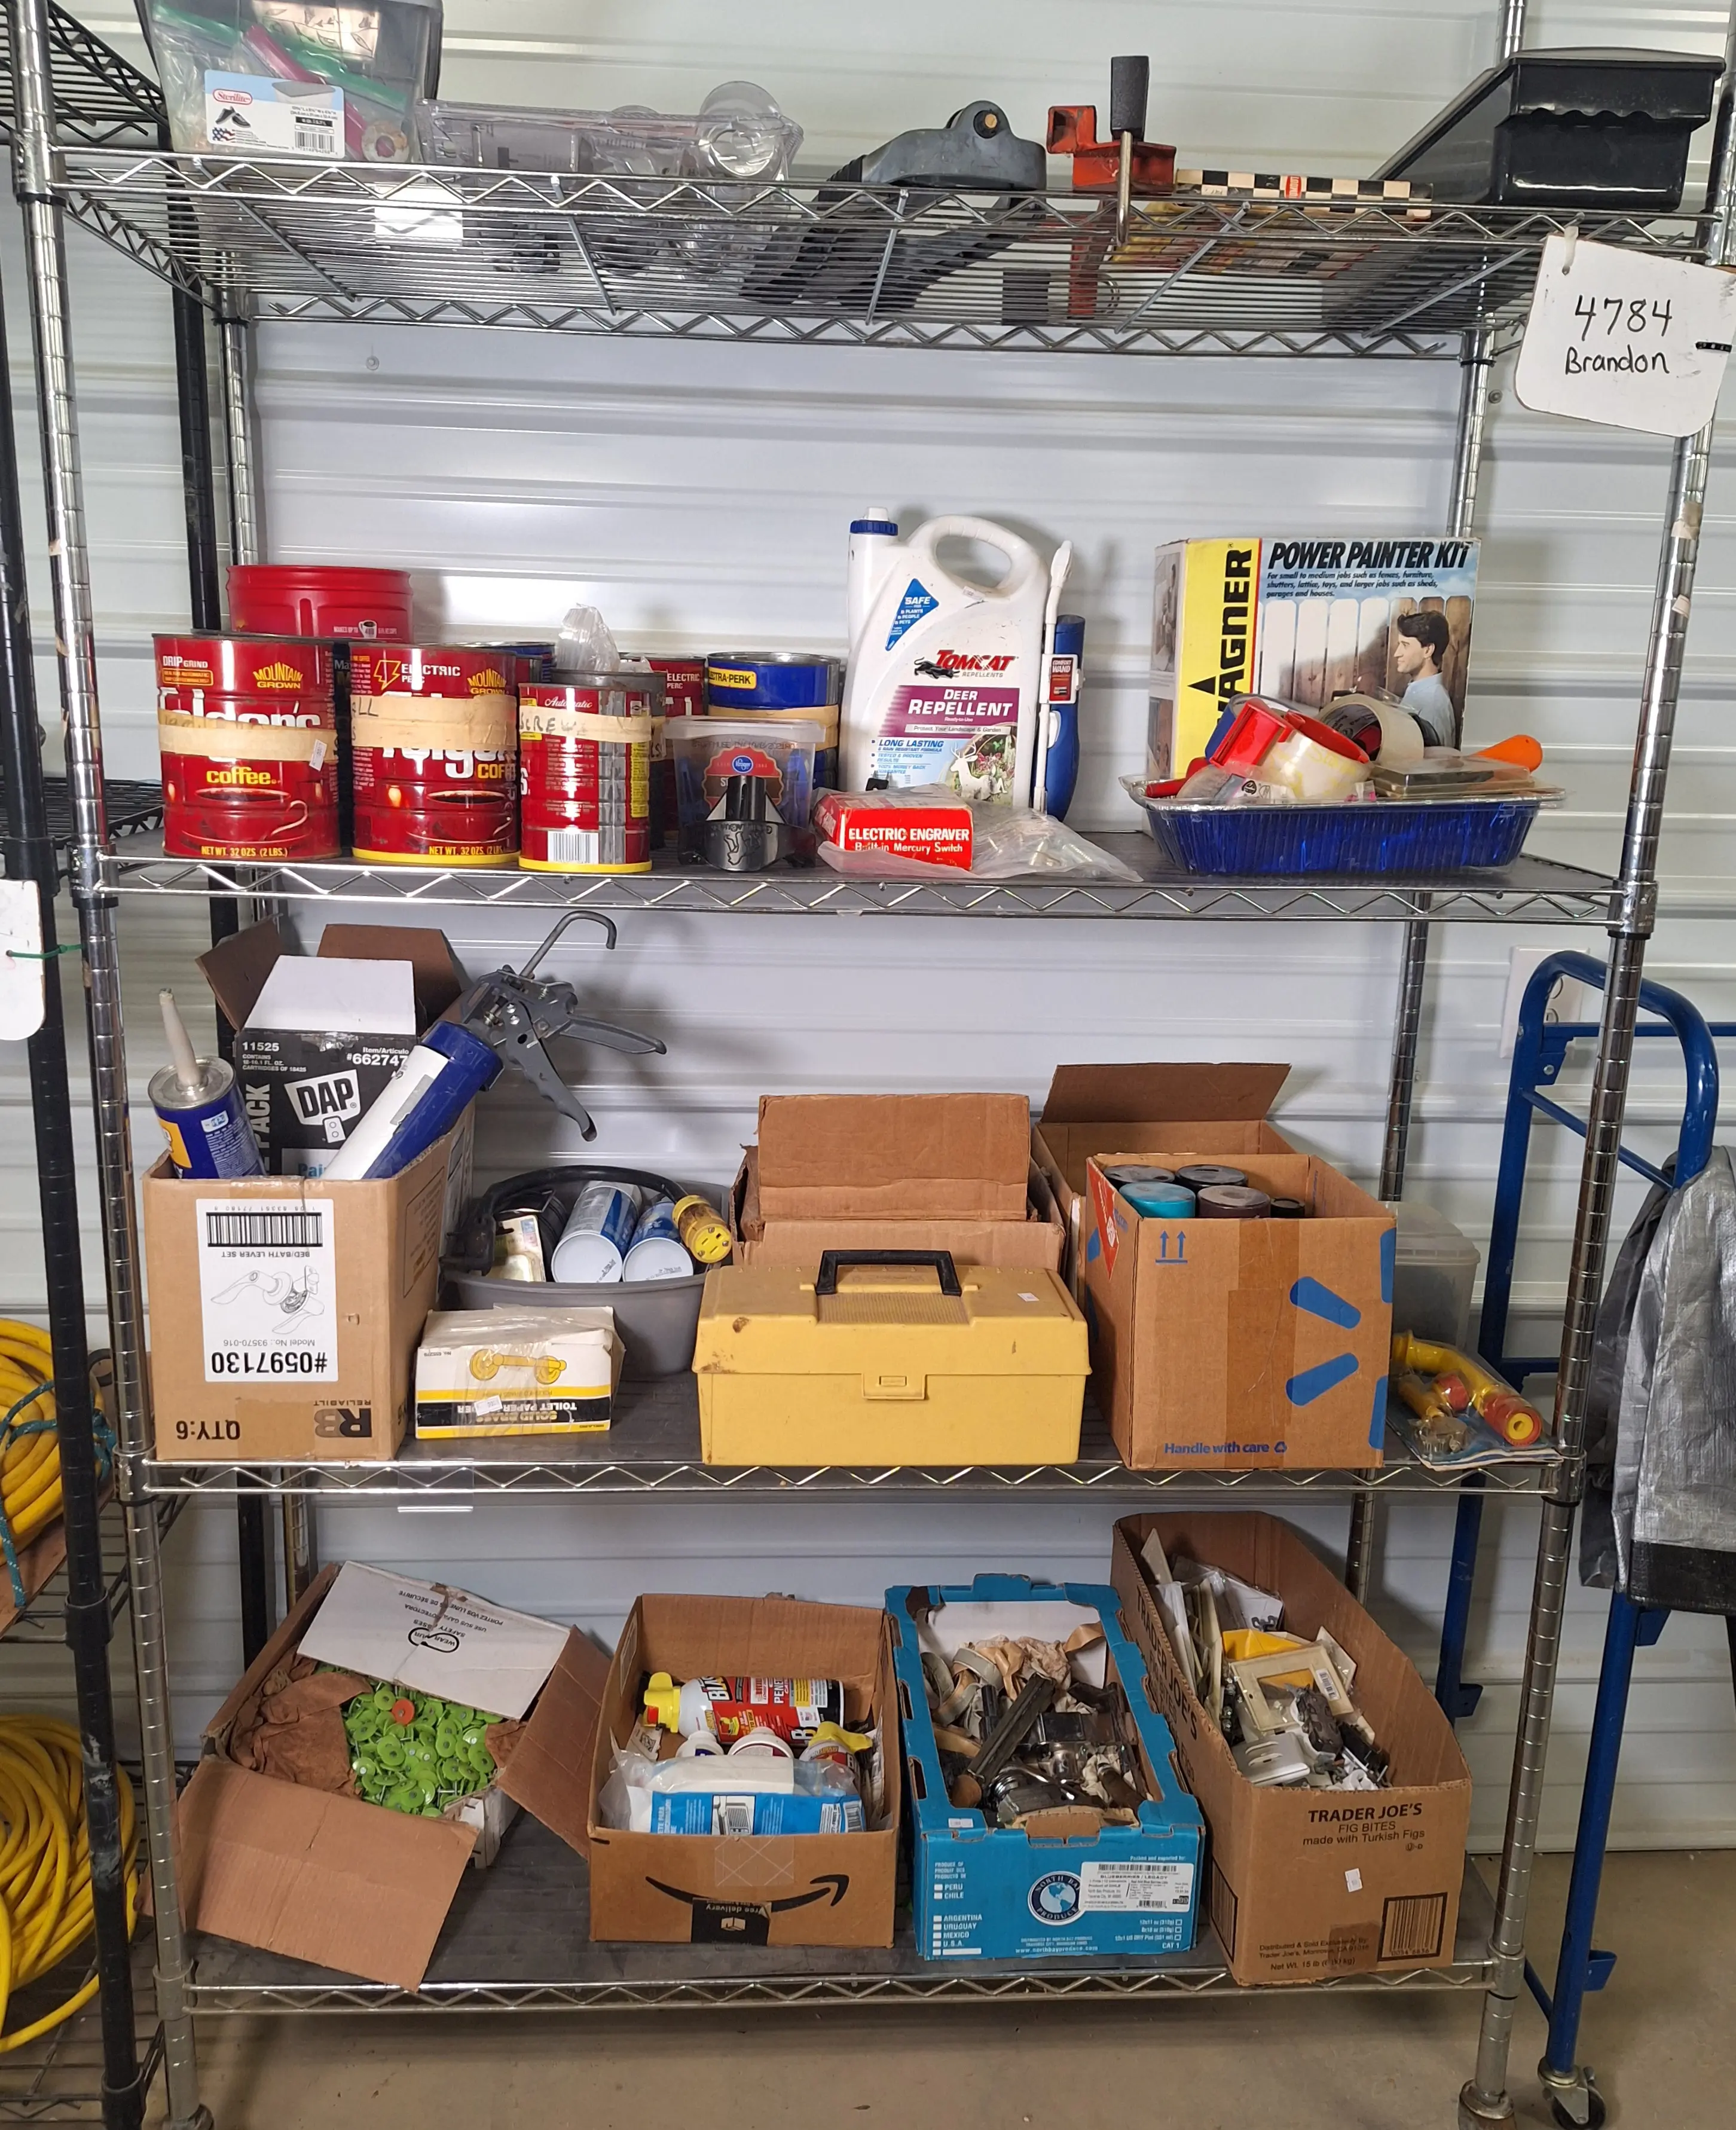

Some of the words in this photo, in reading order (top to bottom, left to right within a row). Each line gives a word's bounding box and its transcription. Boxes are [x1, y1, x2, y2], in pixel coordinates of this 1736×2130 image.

[218, 91, 248, 103] Sterilite
[1575, 295, 1673, 341] 4784
[1565, 344, 1670, 375] Brandon
[1268, 542, 1346, 569] POWER
[1346, 542, 1434, 569] PAINTER
[1434, 542, 1474, 569] KIT
[1337, 572, 1350, 580] jobs
[1298, 580, 1320, 589] lattice,
[1355, 580, 1374, 589] larger
[1266, 590, 1293, 598] garages
[1217, 549, 1252, 725] AGNER
[163, 656, 183, 667] DRIP
[184, 660, 208, 668] GRIND
[935, 649, 1017, 671] TOMCAT
[253, 662, 303, 682] MOUNTAIN
[402, 664, 461, 676] ELCTRIC
[667, 673, 701, 682] ELECTRIC
[944, 689, 979, 701] DEER
[545, 696, 592, 708] Autoatic
[908, 699, 1013, 716] REPELLENT
[735, 759, 751, 770] Kroger
[206, 766, 271, 784] coffee
[849, 828, 907, 841] ELECTRIC
[910, 828, 969, 841] ENGRAVER
[201, 846, 216, 855] NET
[230, 848, 239, 857] 32
[260, 848, 268, 857] (2
[269, 847, 288, 857] LBS.)
[429, 846, 443, 855] NET
[444, 847, 459, 855] WT.
[461, 847, 470, 855] 32
[470, 847, 485, 855] OZS.
[893, 842, 931, 855] Mercury
[934, 842, 962, 852] Switch
[242, 1042, 280, 1052] 11525
[347, 1053, 408, 1066] #662747
[296, 1078, 354, 1119] DAP
[246, 1083, 271, 1148] PACK
[211, 1352, 328, 1374] #0597130
[503, 1403, 538, 1412] PAPER
[540, 1402, 577, 1411] TOILET
[519, 1410, 557, 1421] SOLID
[314, 1408, 372, 1438] RB
[176, 1420, 240, 1440] QTY:6
[1164, 1443, 1211, 1453] Handle
[1212, 1442, 1240, 1453] with
[1242, 1444, 1270, 1453] care
[479, 1615, 503, 1625] PORTEZ
[438, 1625, 466, 1637] SAFETY
[435, 1636, 456, 1646] WEAR
[1137, 1585, 1167, 1673] TRADER
[1169, 1668, 1197, 1741] JOE'S
[1308, 1807, 1375, 1823] TRADER
[1377, 1803, 1422, 1819] JOE'S
[1338, 1823, 1358, 1833] FIG
[1362, 1821, 1396, 1832] BITES
[1303, 1836, 1333, 1846] made
[1336, 1833, 1358, 1844] with
[1362, 1830, 1399, 1843] Turkish
[1402, 1829, 1425, 1841] Figs
[1035, 1876, 1063, 1891] NORTH
[705, 1903, 742, 1914] delivery
[1037, 1907, 1078, 1920] PRODUCE
[1260, 1943, 1295, 1951] Distributed
